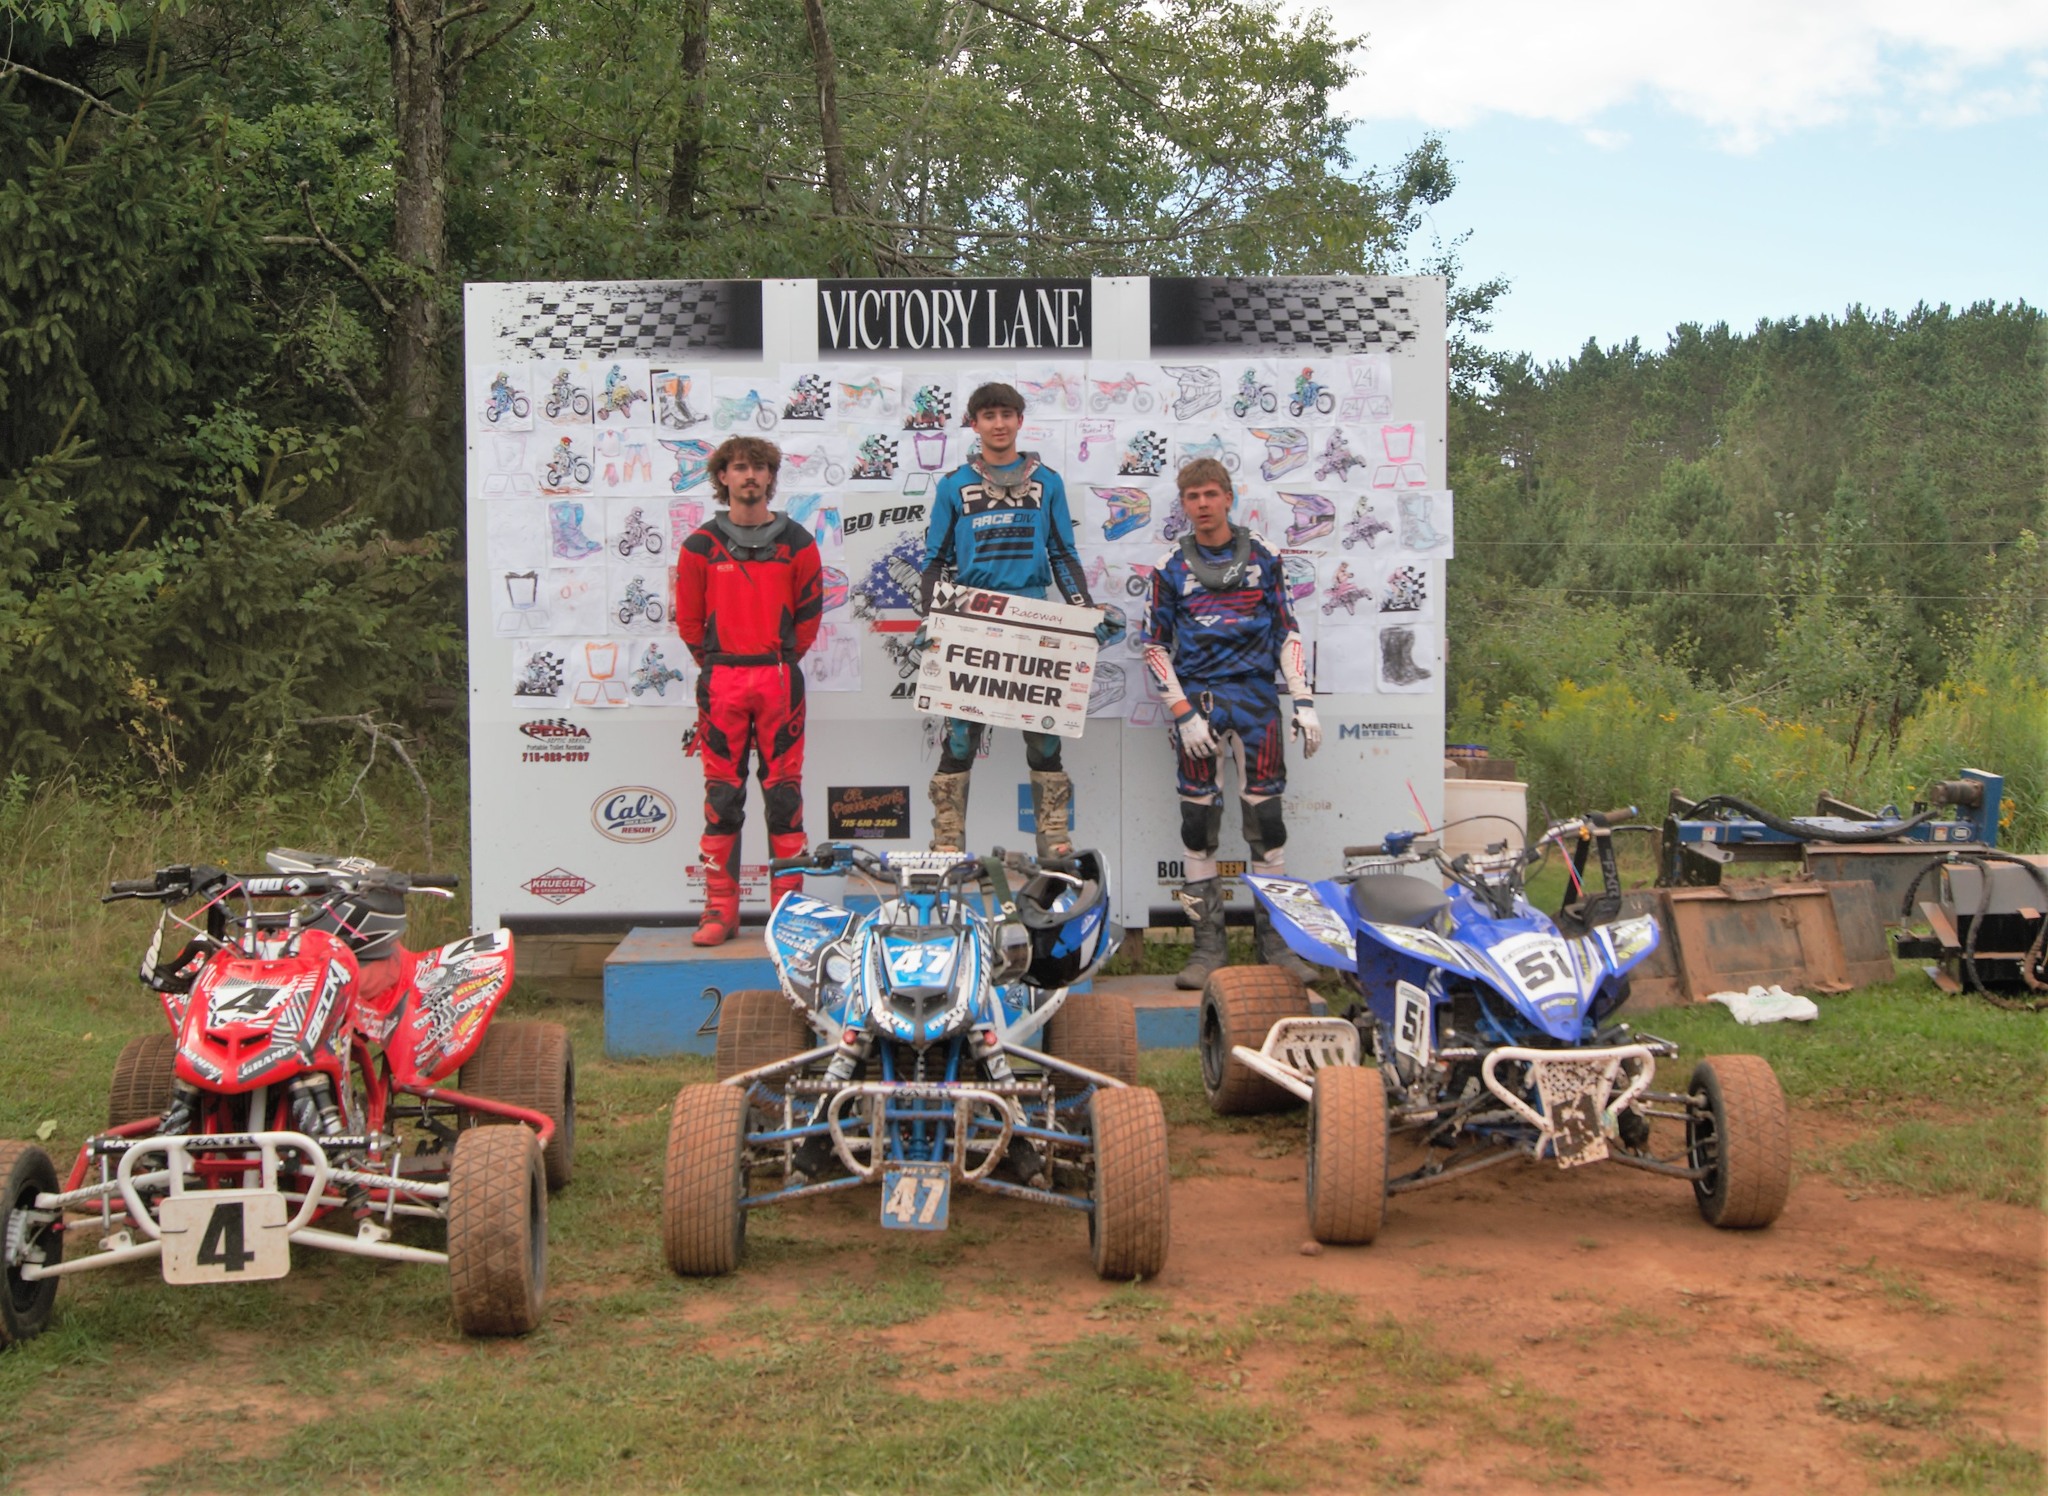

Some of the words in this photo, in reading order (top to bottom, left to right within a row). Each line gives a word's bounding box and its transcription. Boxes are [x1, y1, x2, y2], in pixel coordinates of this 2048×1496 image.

[821, 288, 978, 350] VICTORY
[987, 288, 1084, 349] LANE
[1354, 367, 1373, 388] 24
[843, 512, 874, 536] GO
[878, 504, 926, 527] FOR
[970, 592, 1010, 616] GFI
[1009, 605, 1063, 625] Raceway
[945, 643, 1073, 682] FEATURE
[948, 671, 1063, 708] WINNER
[528, 727, 591, 738] PECHA
[604, 794, 665, 823] Cal's
[621, 826, 657, 834] RESORT
[532, 880, 584, 888] KRUEGER
[784, 900, 850, 919] 47
[448, 932, 502, 959] 4
[892, 949, 951, 974] 47
[1515, 949, 1574, 991] 51
[216, 987, 281, 1014] 4
[696, 987, 722, 1036] 2
[1402, 1000, 1426, 1043] 51
[1294, 1033, 1337, 1043] XFR
[318, 1136, 365, 1145] RATH
[885, 1176, 946, 1224] 47
[197, 1202, 255, 1272] 4
